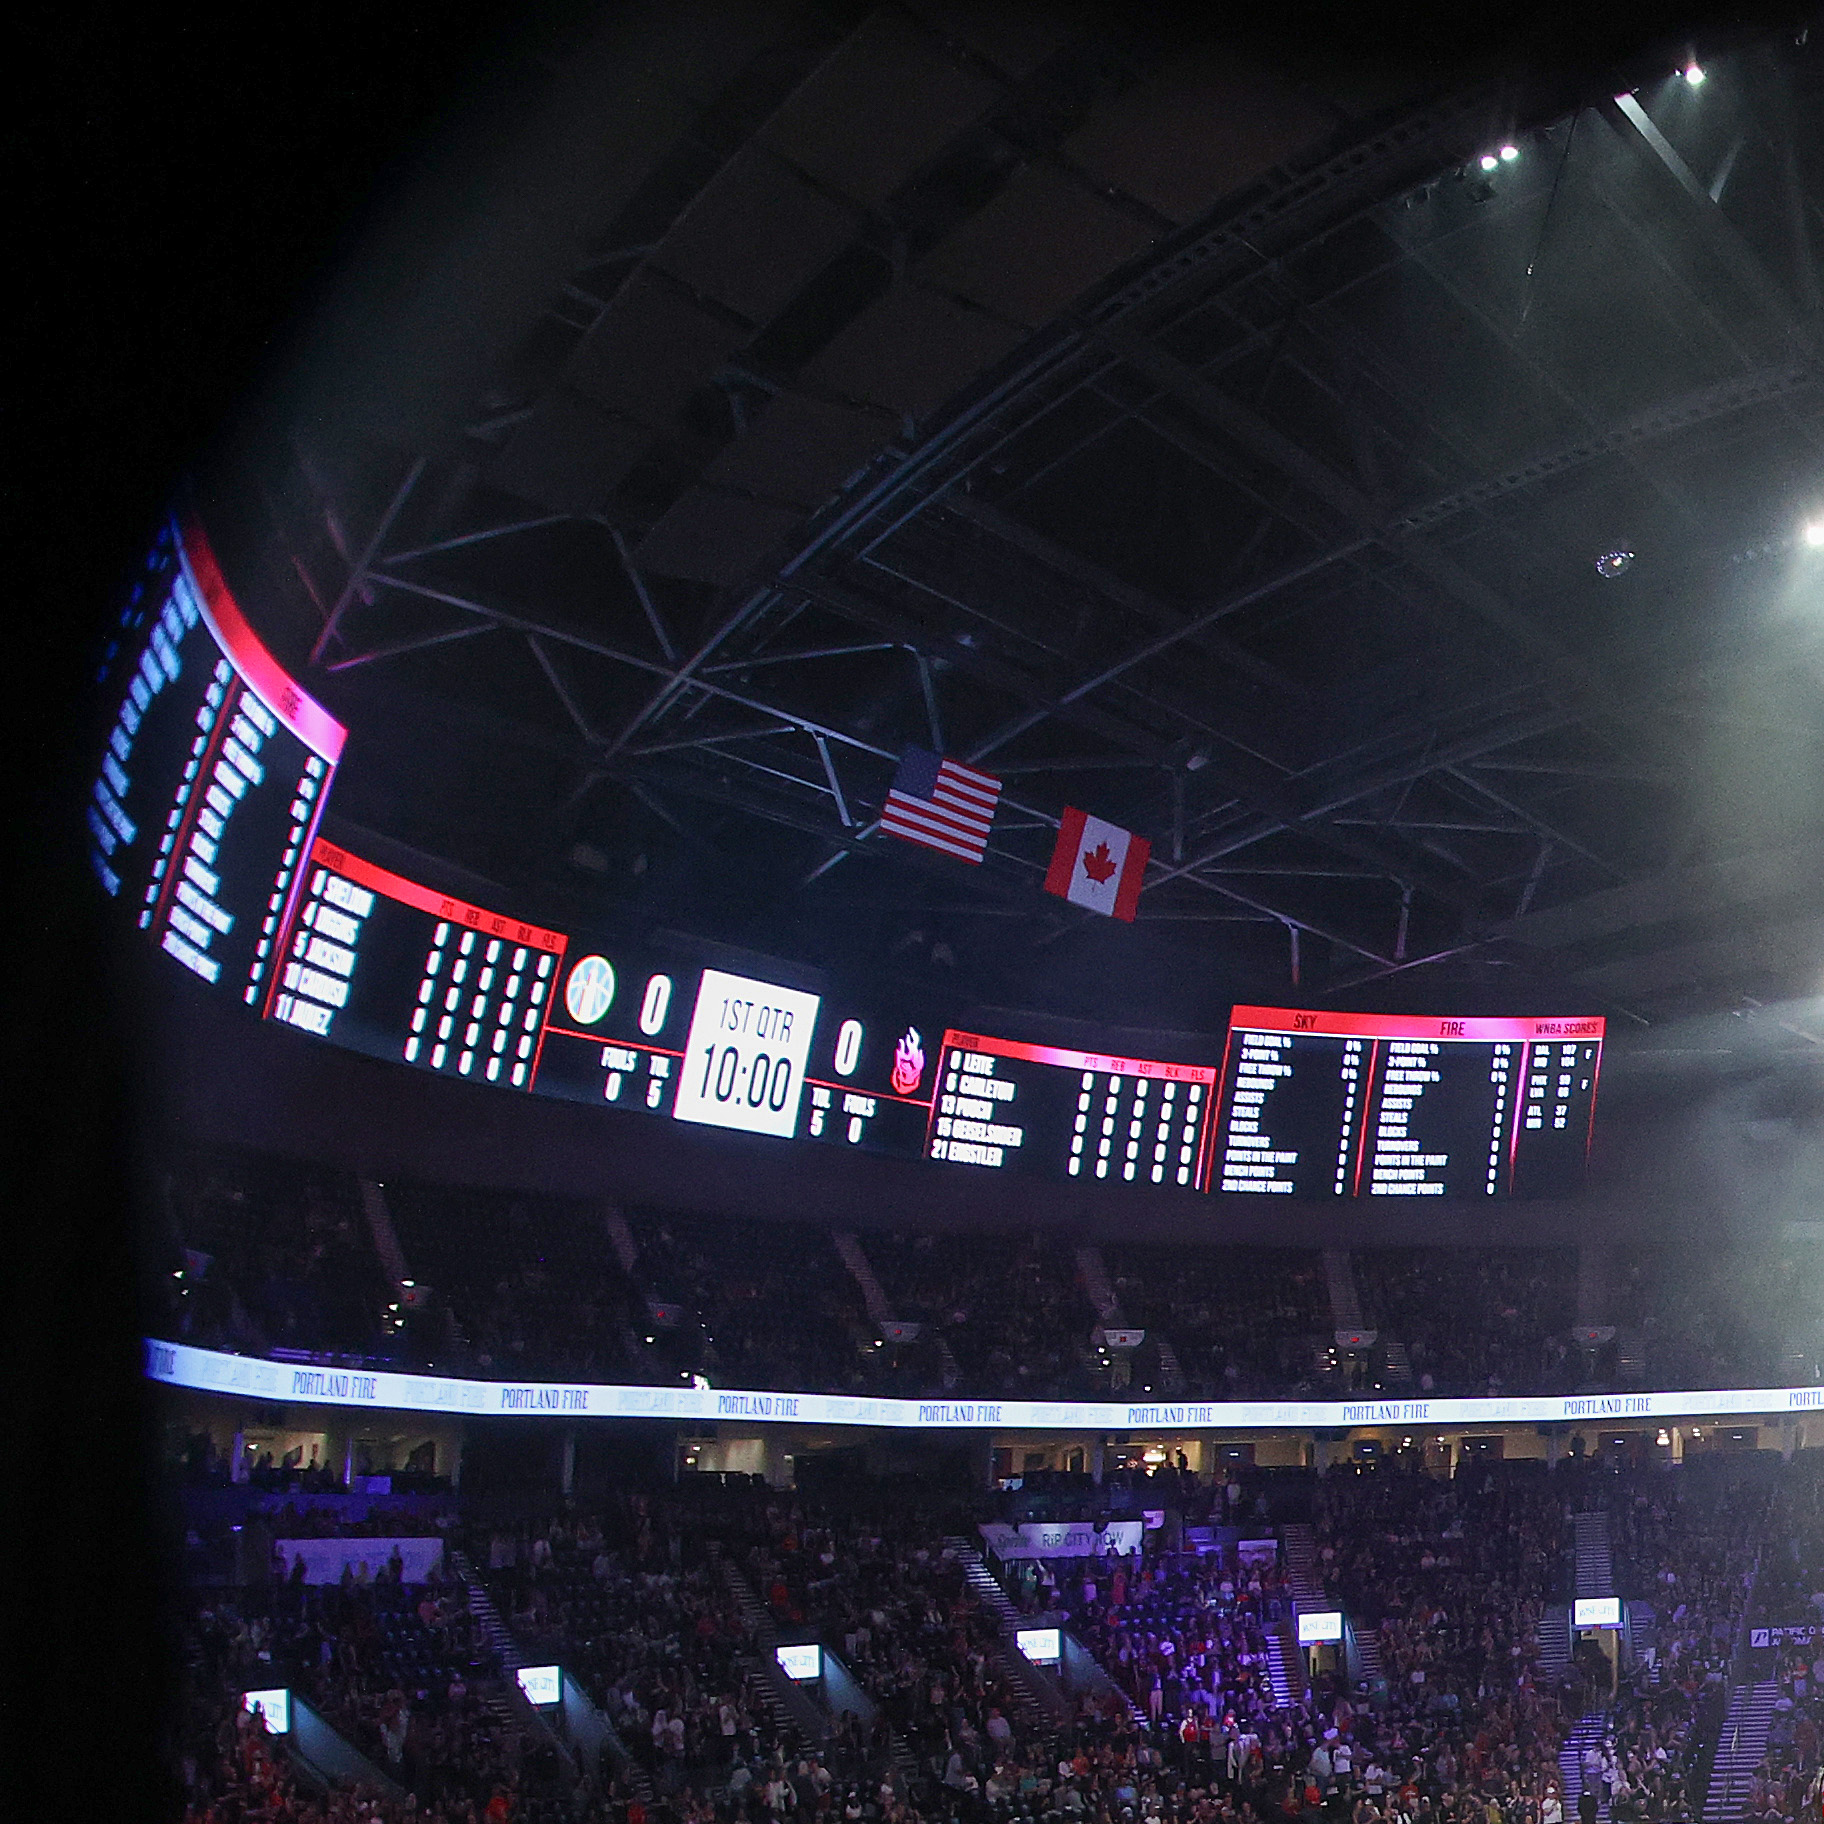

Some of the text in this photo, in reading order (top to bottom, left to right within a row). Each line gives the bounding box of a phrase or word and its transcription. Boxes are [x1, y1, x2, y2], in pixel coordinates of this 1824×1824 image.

[639, 973, 673, 1036] 0
[720, 997, 795, 1044] 1ST QTR
[1293, 1013, 1318, 1029] SKY
[1439, 1021, 1466, 1037] FIRE
[1535, 1021, 1598, 1034] WNBA SCORES
[834, 1018, 863, 1076] 0
[604, 1072, 622, 1101] 0
[700, 1042, 792, 1112] 10:00
[646, 1079, 663, 1109] 5
[809, 1109, 826, 1137] 5
[846, 1117, 863, 1144] 0
[931, 1138, 949, 1160] 21
[292, 1371, 378, 1399] PORTLAND FIRE
[501, 1388, 589, 1410] PORTLAND FIRE
[718, 1395, 800, 1416] PORTLAND FIRE
[1563, 1398, 1652, 1416] PORTLAND FIRE
[918, 1405, 1003, 1422] PORTLAND FIRE
[1128, 1406, 1213, 1423] PORTLAND FIRE
[1343, 1403, 1430, 1421] PORTLAND FIRE
[1101, 1532, 1124, 1546] OW
